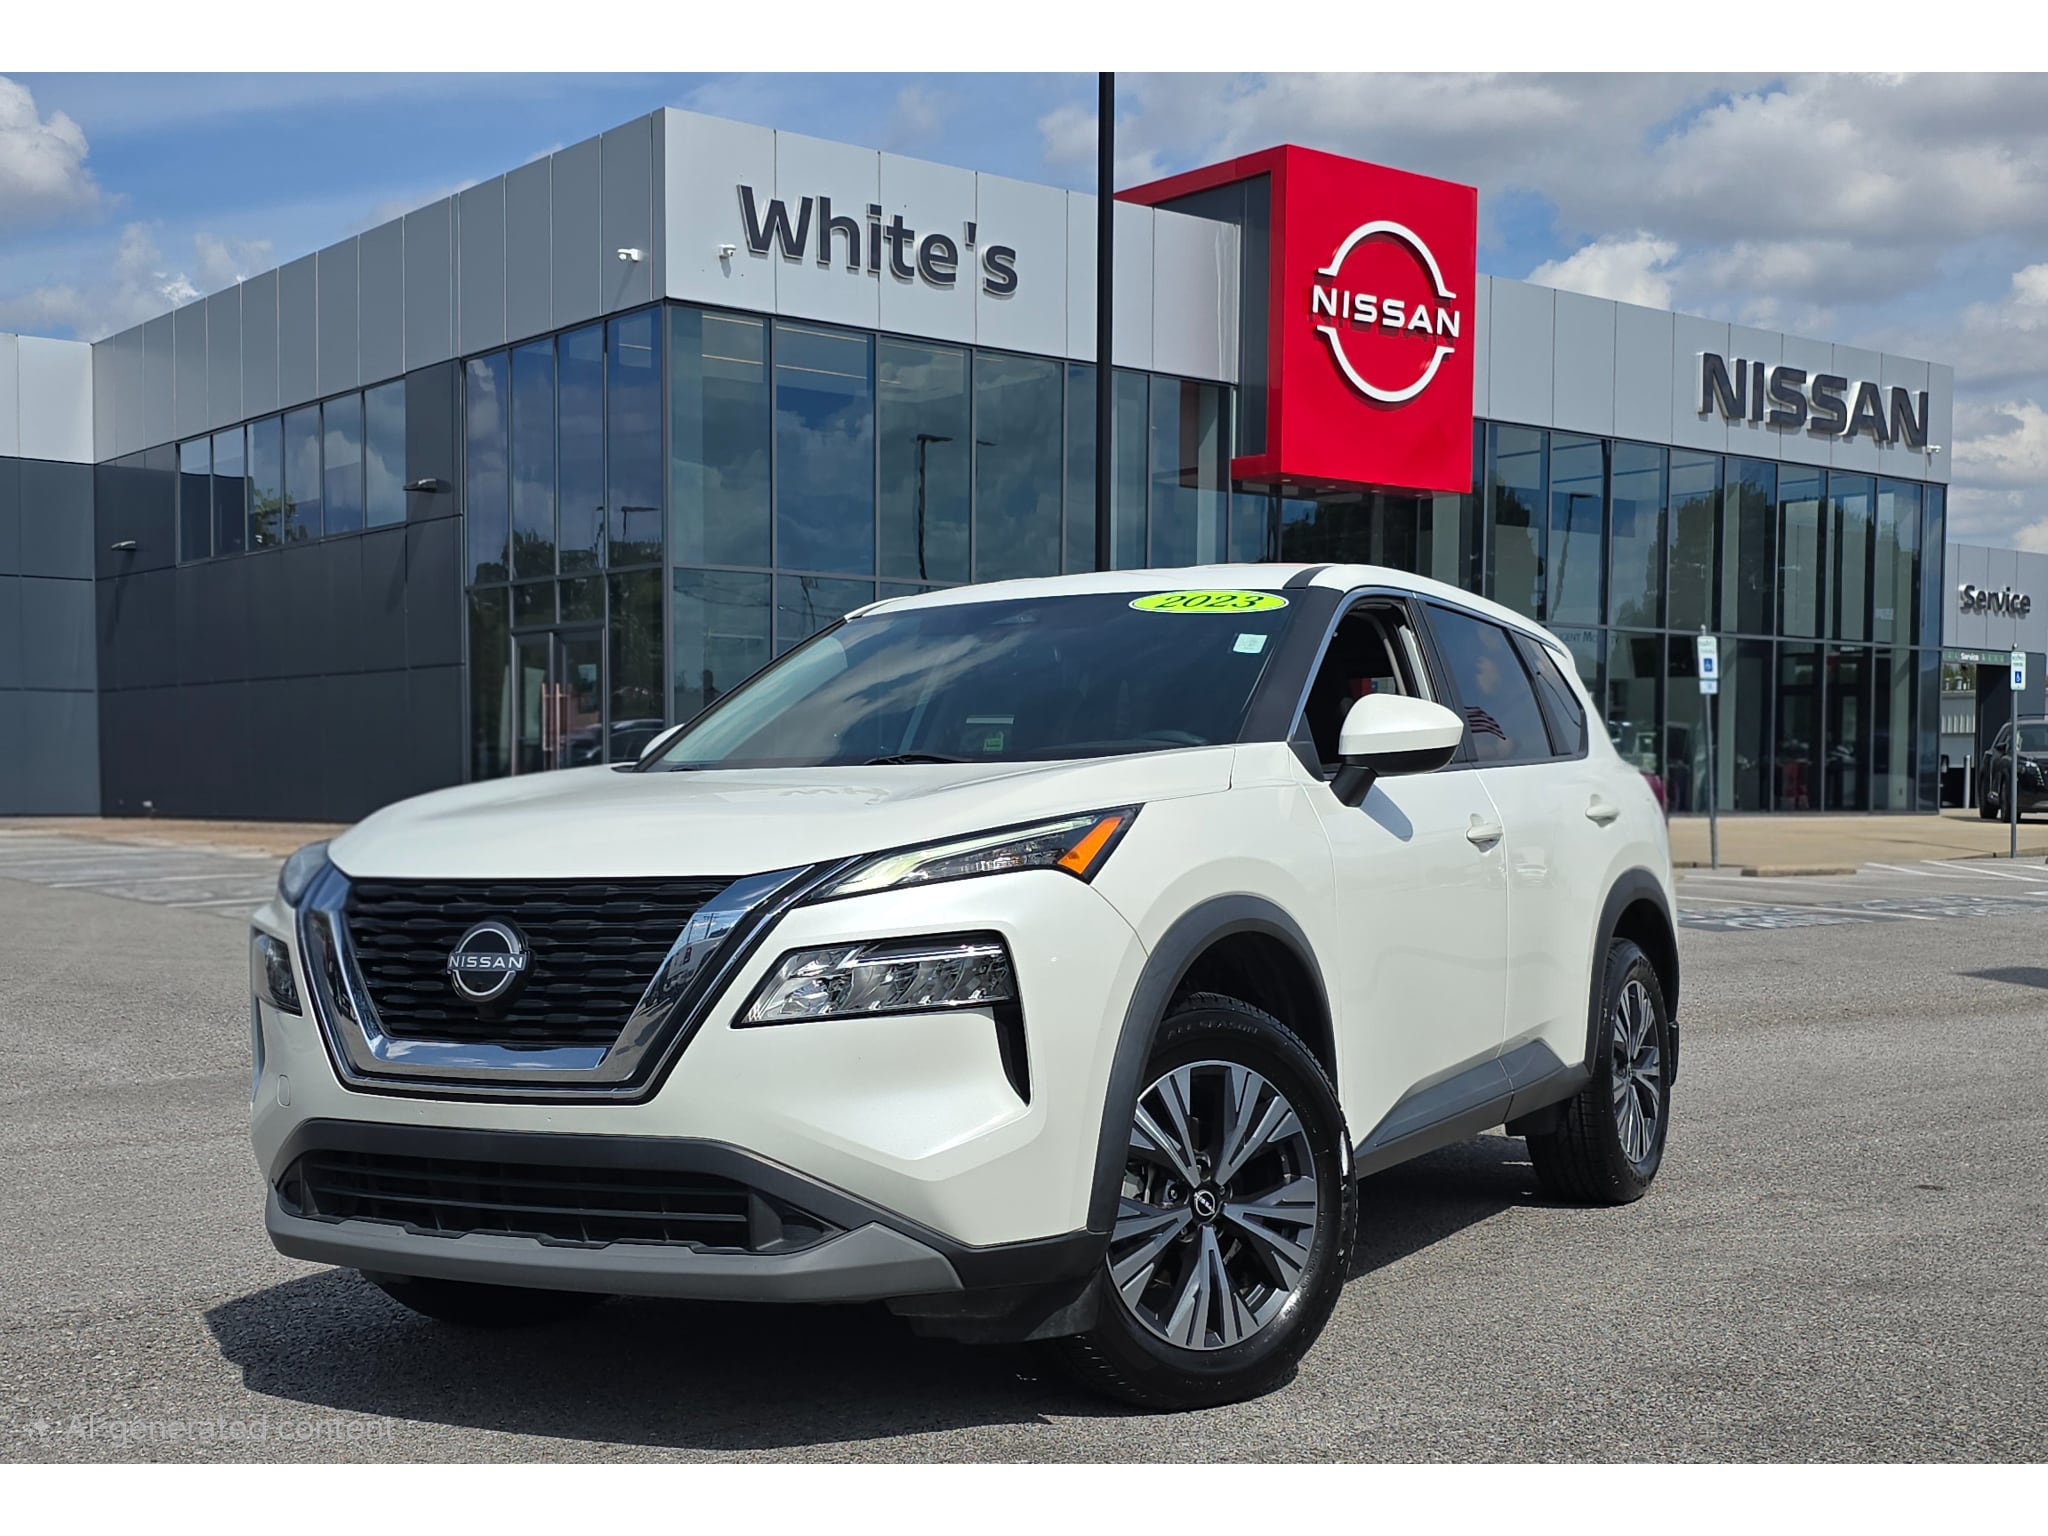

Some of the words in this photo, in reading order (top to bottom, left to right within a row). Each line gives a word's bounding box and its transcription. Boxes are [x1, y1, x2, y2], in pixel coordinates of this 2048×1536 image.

[737, 184, 1018, 295] White's
[1312, 284, 1460, 338] NISSAN
[1699, 352, 1929, 448] NISSAN
[1155, 594, 1264, 609] 2023
[1961, 584, 2031, 614] Service
[449, 956, 523, 969] NISSAN
